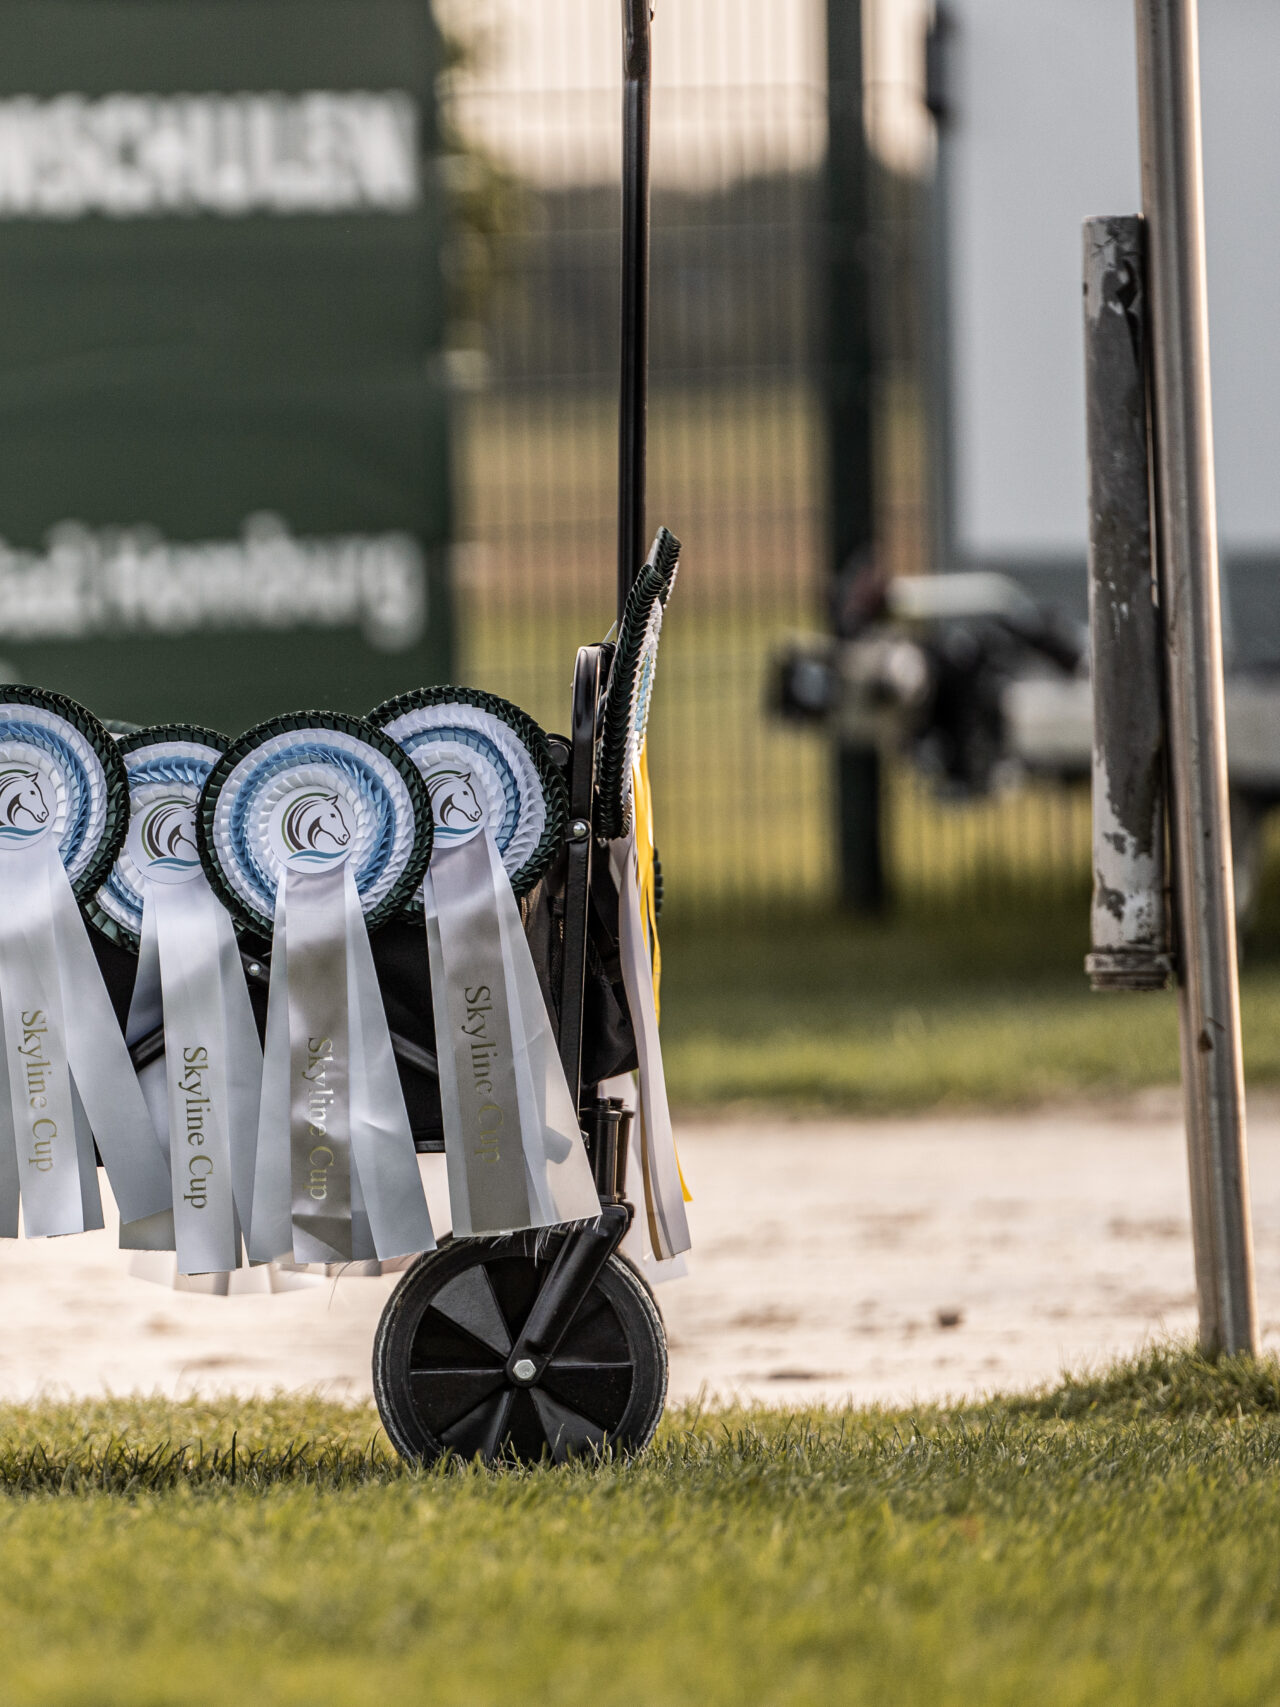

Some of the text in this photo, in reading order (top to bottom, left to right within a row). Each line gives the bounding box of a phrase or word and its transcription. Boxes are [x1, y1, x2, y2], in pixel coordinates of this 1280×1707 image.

[18, 1009, 57, 1172] Skyline Cup
[178, 1046, 214, 1209] Skyline Cup
[302, 1037, 335, 1200] Skyline Cup
[461, 986, 504, 1164] Skyline Cup
